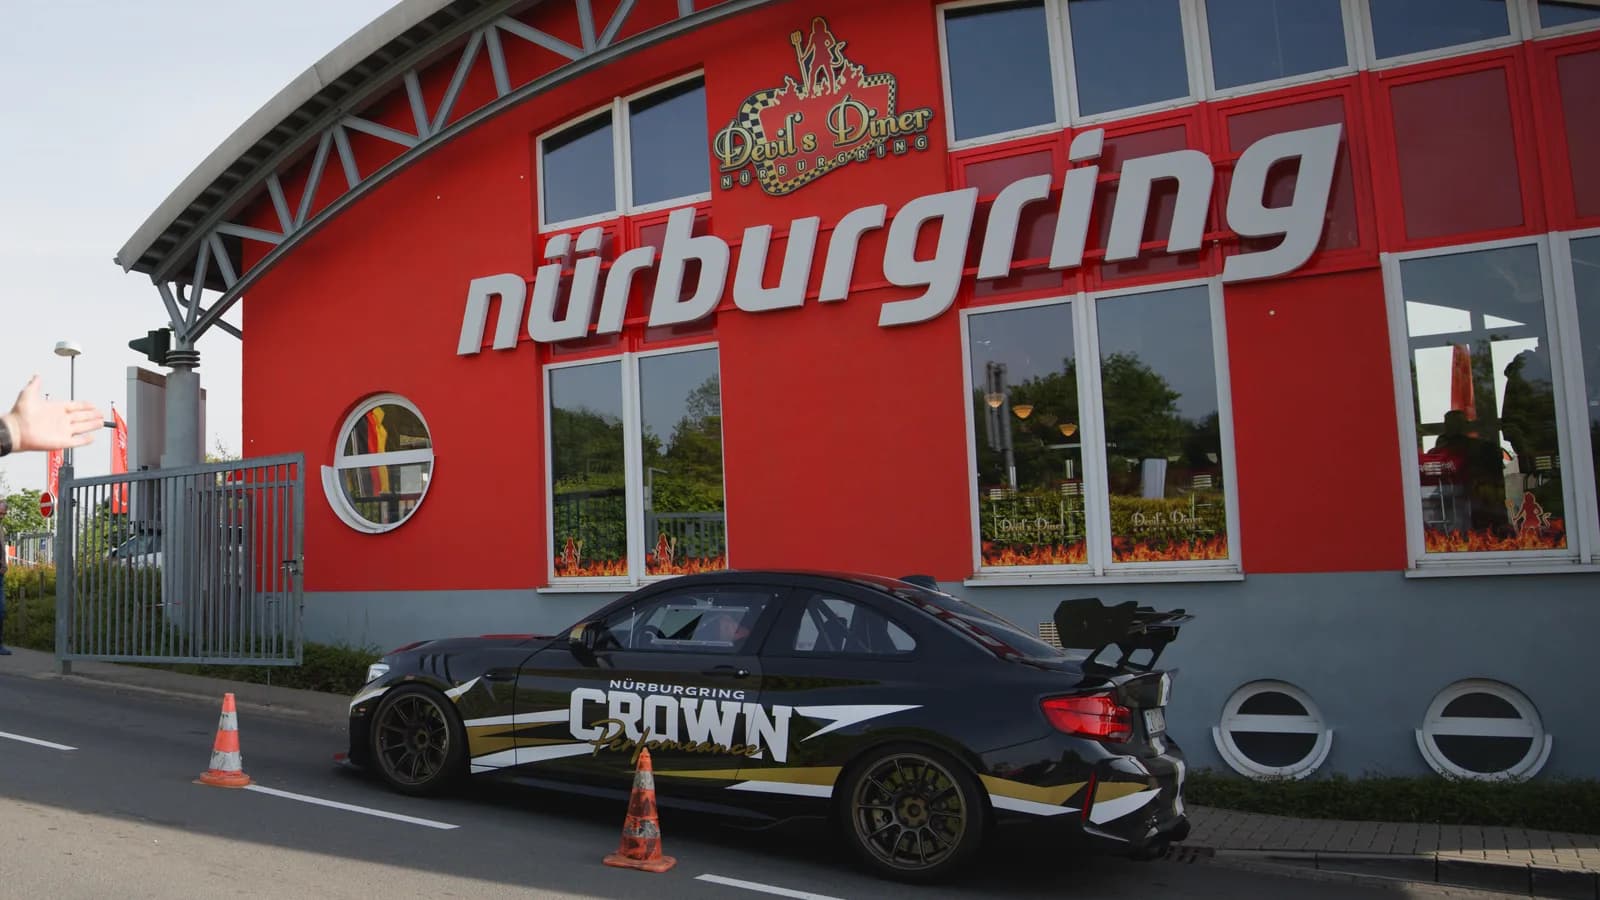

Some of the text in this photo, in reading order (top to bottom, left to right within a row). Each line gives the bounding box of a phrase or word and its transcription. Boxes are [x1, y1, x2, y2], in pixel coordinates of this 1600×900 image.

[714, 94, 933, 172] Devil's Diner
[720, 136, 928, 190] NÜRBURGRING
[457, 123, 1343, 356] nürburgring
[569, 687, 792, 763] CROWN
[610, 678, 745, 700] NÜRBURGRING
